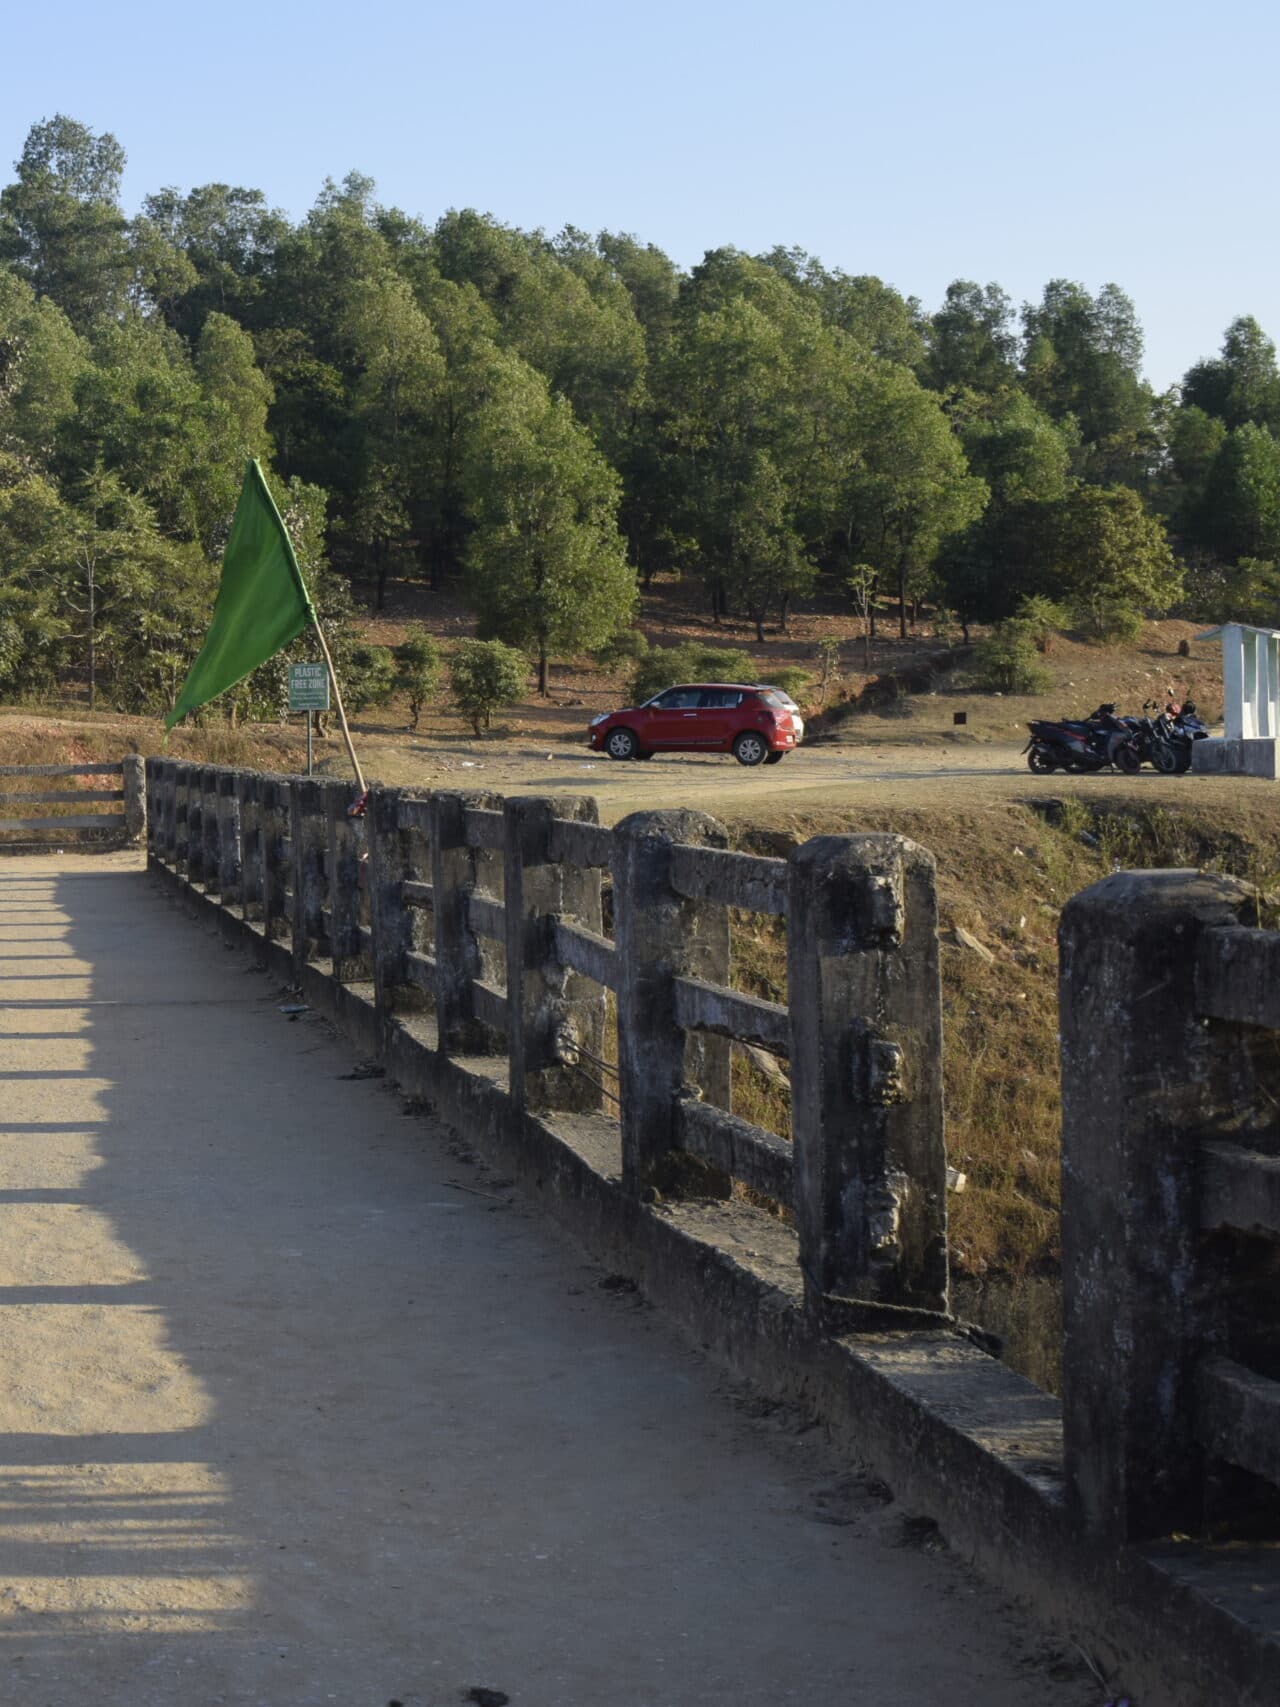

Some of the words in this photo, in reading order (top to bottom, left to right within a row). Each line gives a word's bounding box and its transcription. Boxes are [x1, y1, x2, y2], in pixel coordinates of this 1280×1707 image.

[294, 667, 321, 677] PLASTIC
[291, 679, 307, 689] FREE
[308, 678, 325, 689] ZONE
